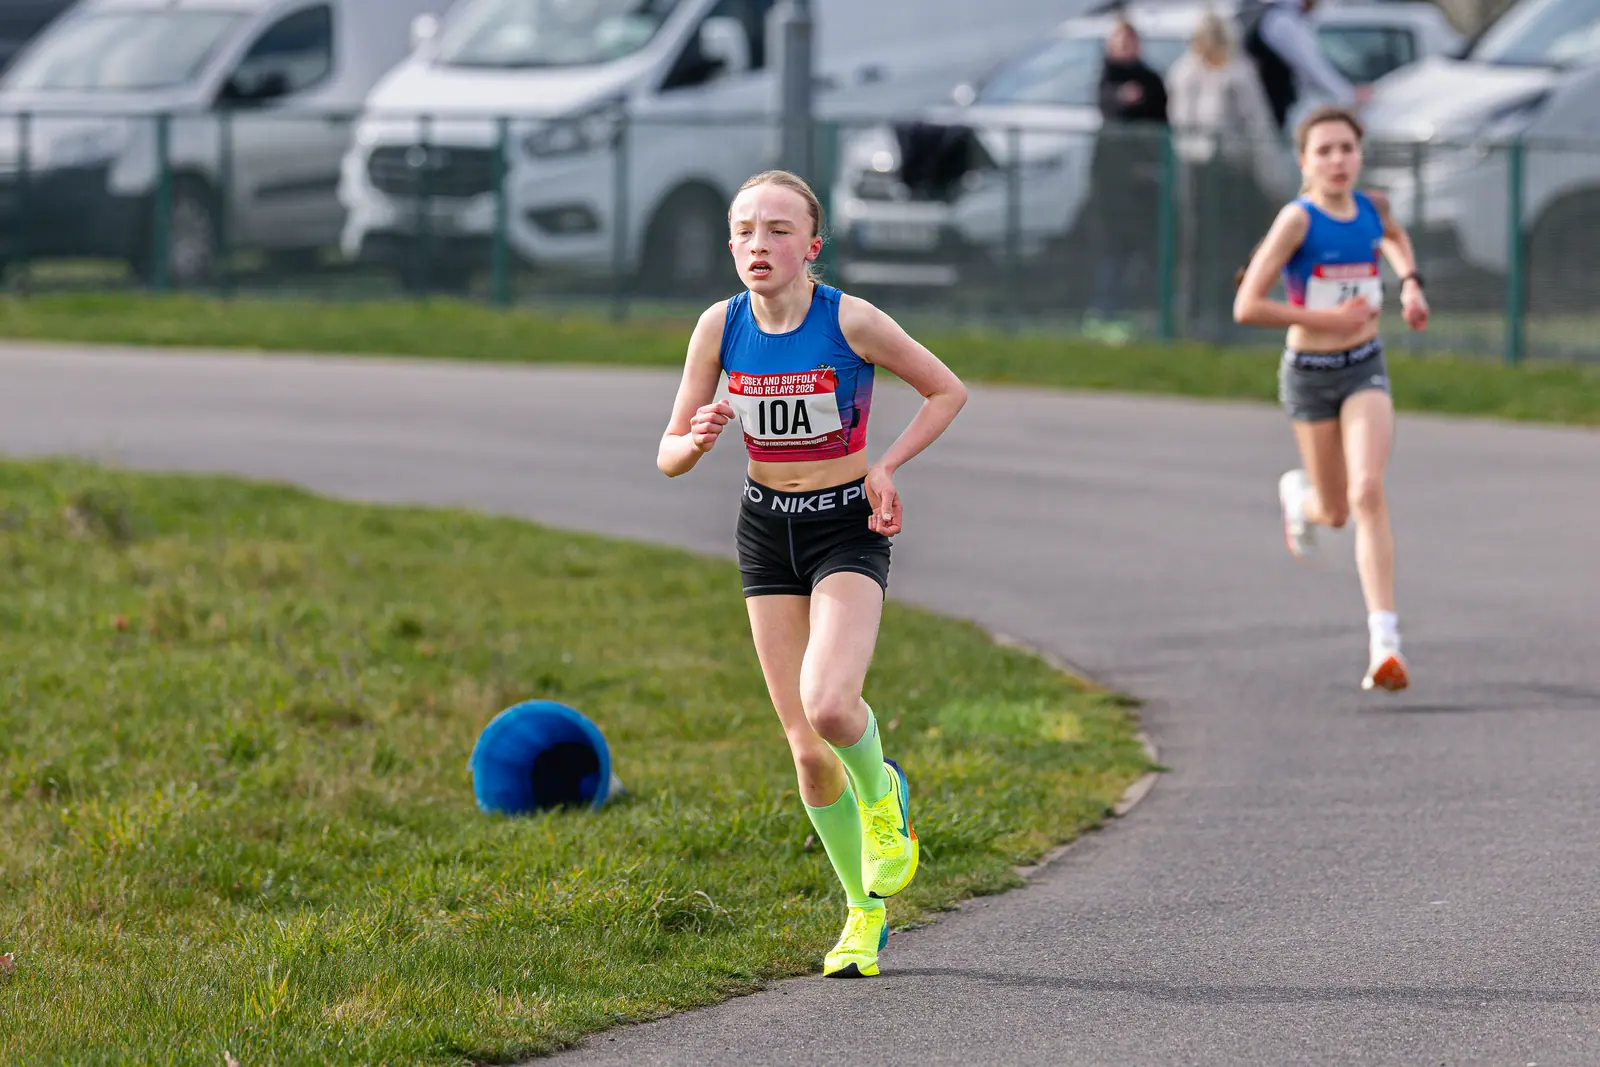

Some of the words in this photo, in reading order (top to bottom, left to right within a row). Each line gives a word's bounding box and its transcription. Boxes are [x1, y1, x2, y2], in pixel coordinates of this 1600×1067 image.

[740, 375, 761, 386] ESSEX
[763, 376, 779, 386] AND
[781, 373, 818, 385] SUFFOLK
[743, 386, 763, 395] ROAD
[765, 385, 794, 395] RELAYS
[795, 384, 815, 393] 2026
[758, 399, 812, 436] 10A
[771, 492, 836, 513] NIKE
